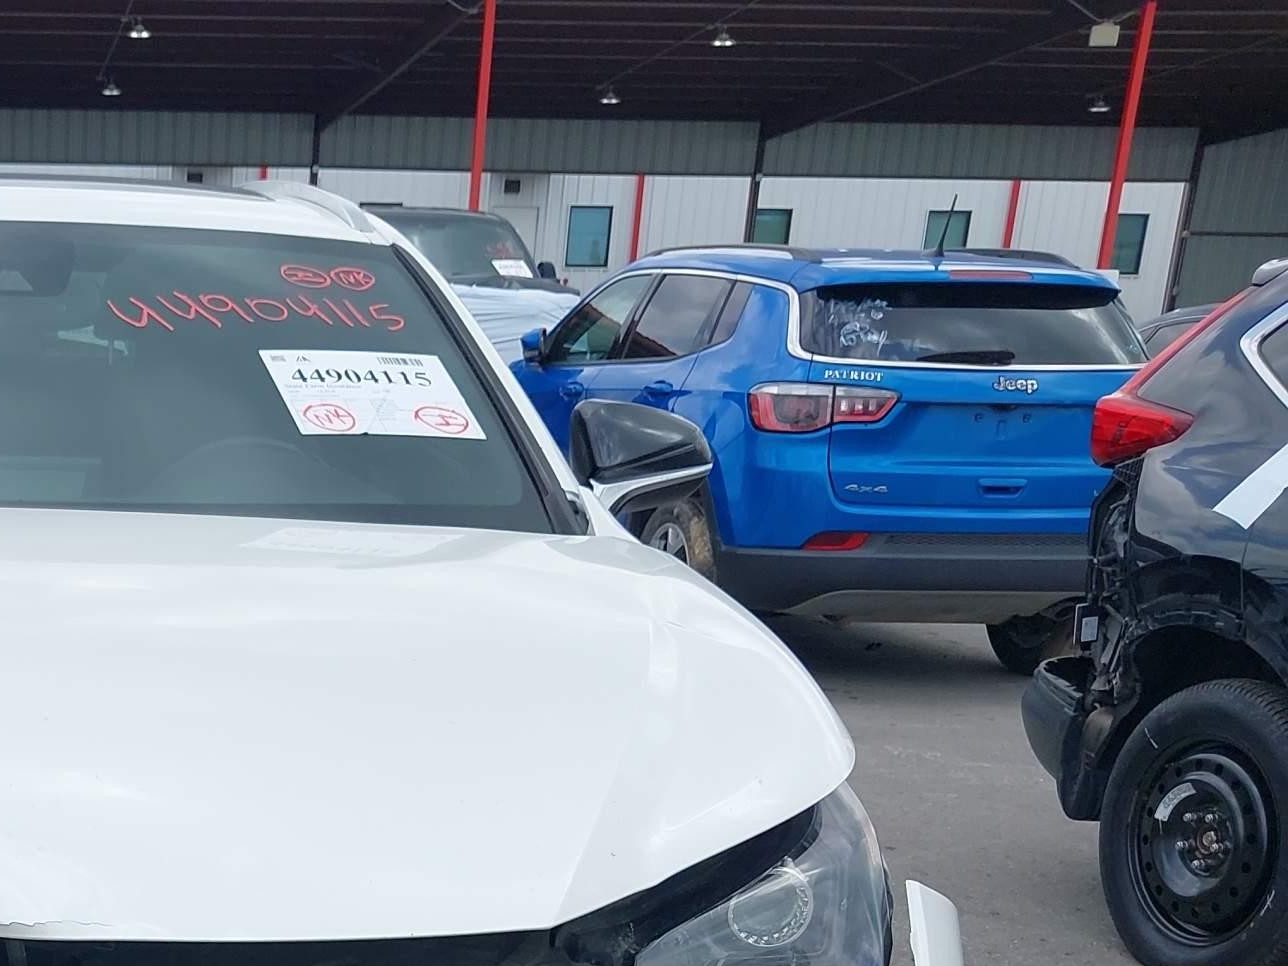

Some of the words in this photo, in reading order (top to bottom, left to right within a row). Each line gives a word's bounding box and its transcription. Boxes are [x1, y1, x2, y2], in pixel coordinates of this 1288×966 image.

[107, 290, 405, 332] 44904115
[291, 368, 432, 387] 44904115
[824, 369, 884, 382] PATRIOT
[993, 376, 1039, 395] Jeep
